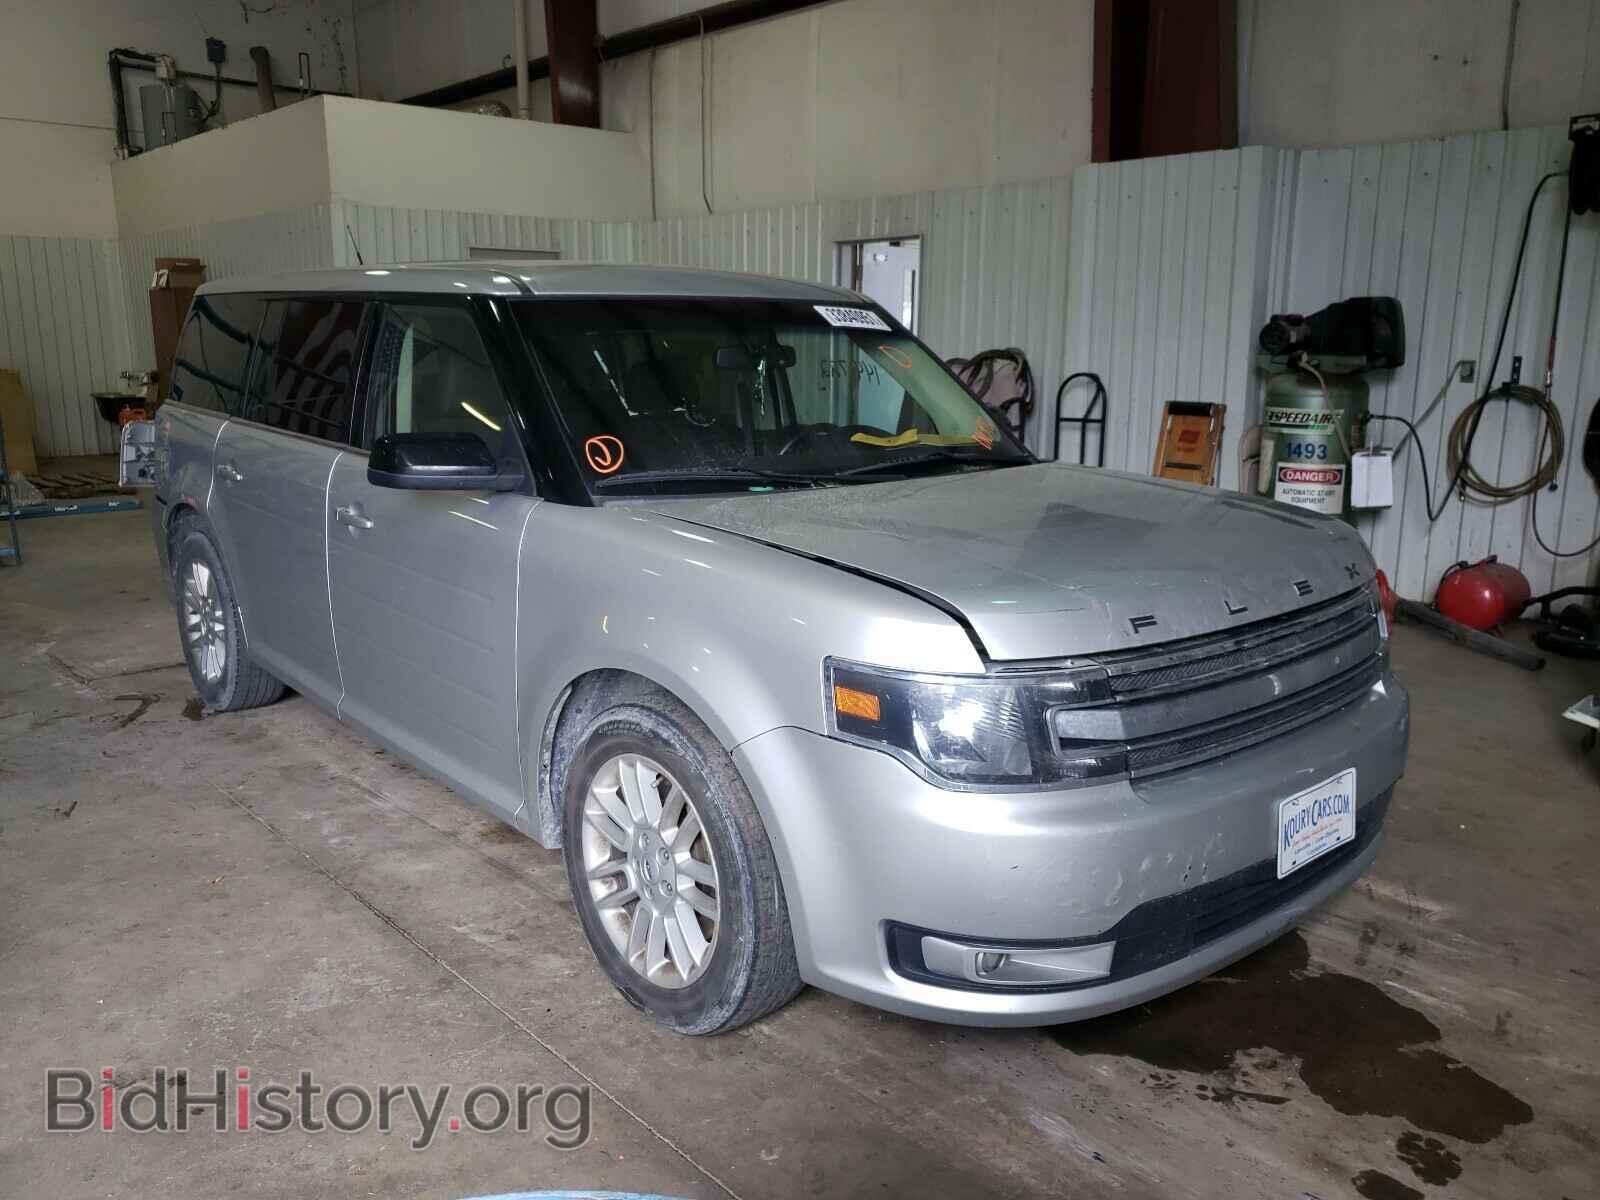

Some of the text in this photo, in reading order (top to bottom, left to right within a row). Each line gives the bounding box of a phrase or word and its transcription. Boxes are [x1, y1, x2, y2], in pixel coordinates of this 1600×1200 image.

[1287, 443, 1328, 459] 1493
[1286, 470, 1334, 481] DANGER
[1128, 562, 1361, 633] FLEX
